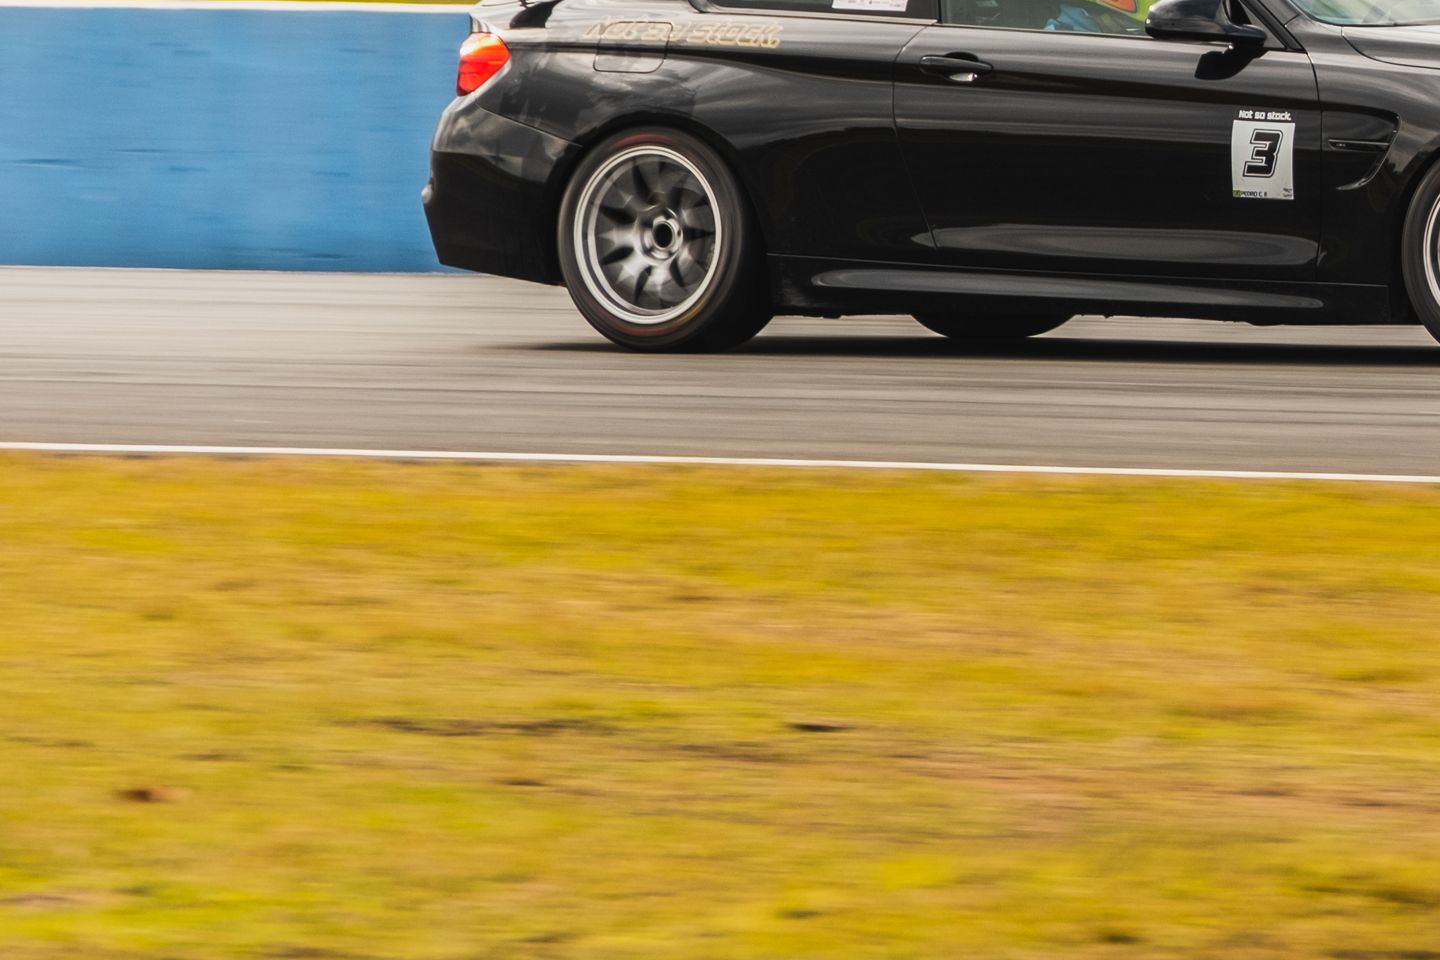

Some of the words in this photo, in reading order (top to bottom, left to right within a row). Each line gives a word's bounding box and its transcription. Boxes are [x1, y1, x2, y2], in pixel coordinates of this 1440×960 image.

[1238, 109, 1254, 119] Not
[1254, 111, 1266, 120] so
[1266, 111, 1292, 121] stock
[1242, 128, 1284, 178] 3
